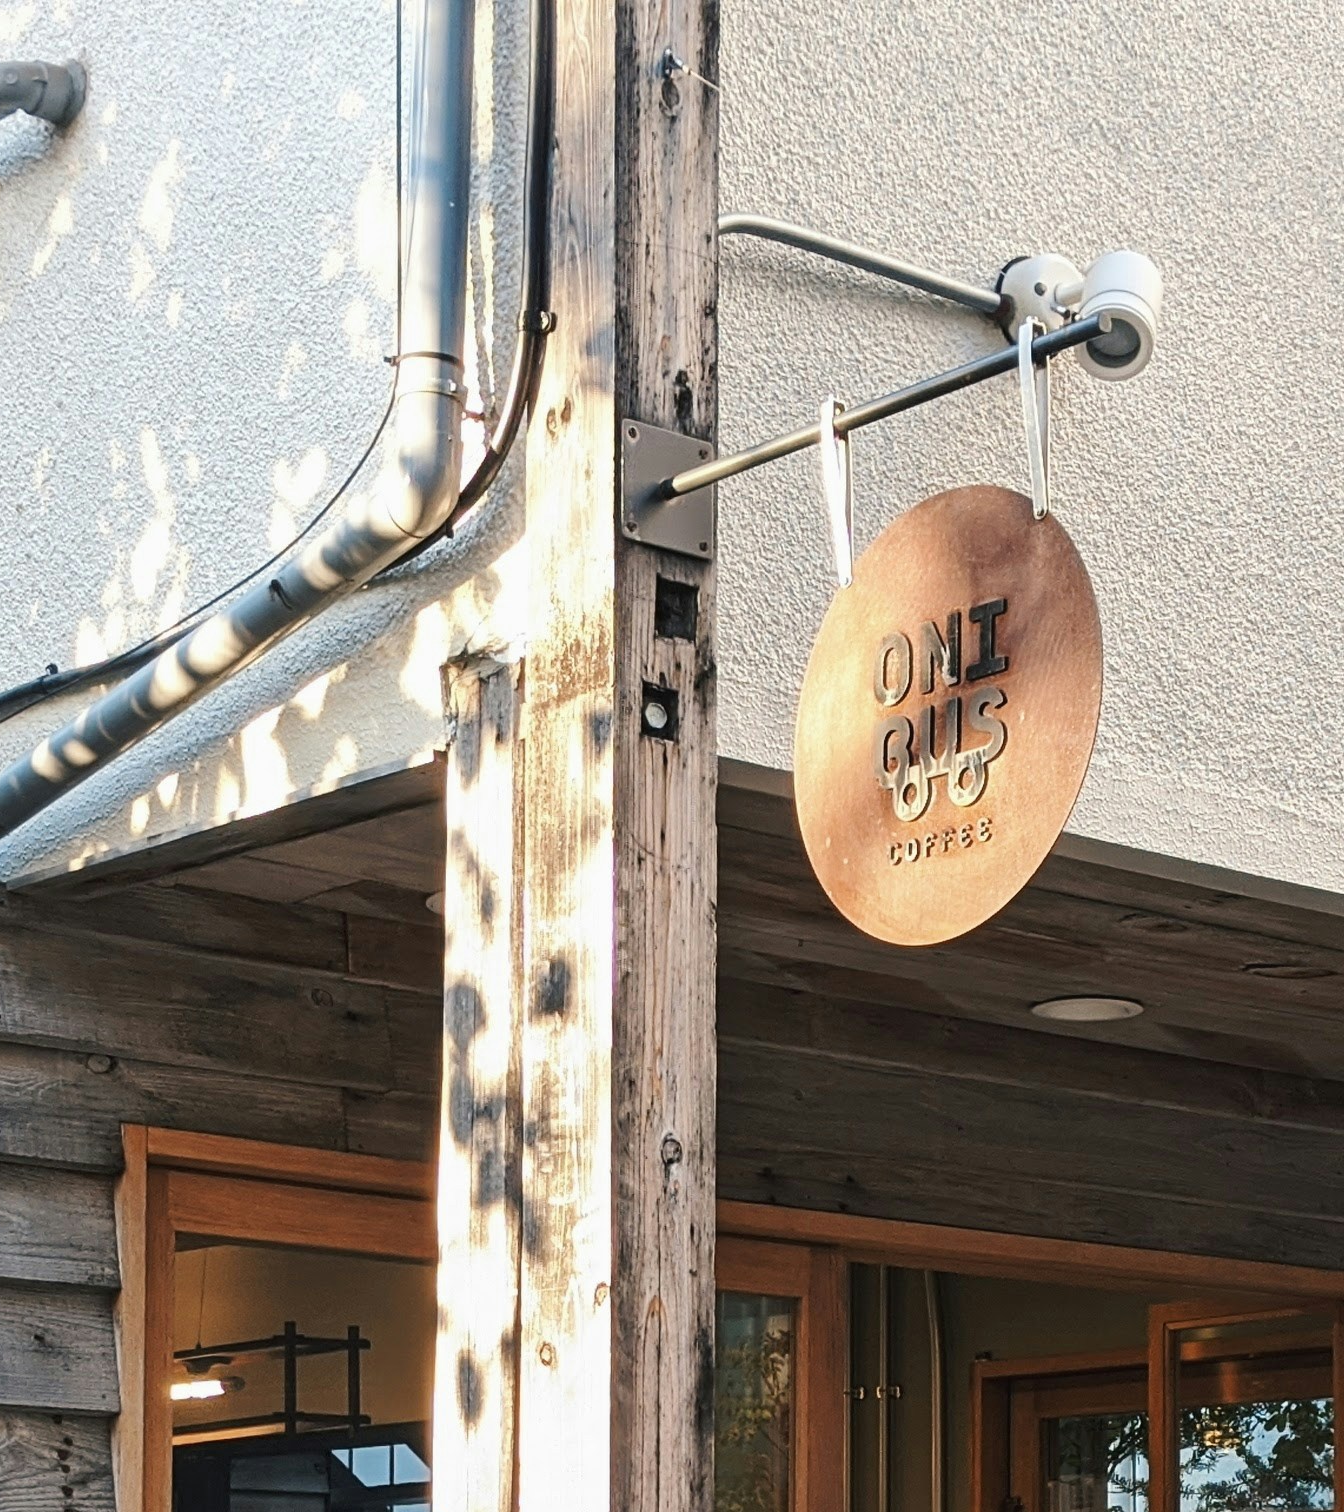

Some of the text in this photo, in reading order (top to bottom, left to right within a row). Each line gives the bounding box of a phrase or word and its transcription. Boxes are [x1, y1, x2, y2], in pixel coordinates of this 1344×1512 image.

[873, 597, 1009, 707] ONI
[873, 686, 1008, 822] BUS
[889, 817, 993, 866] COFFEE
